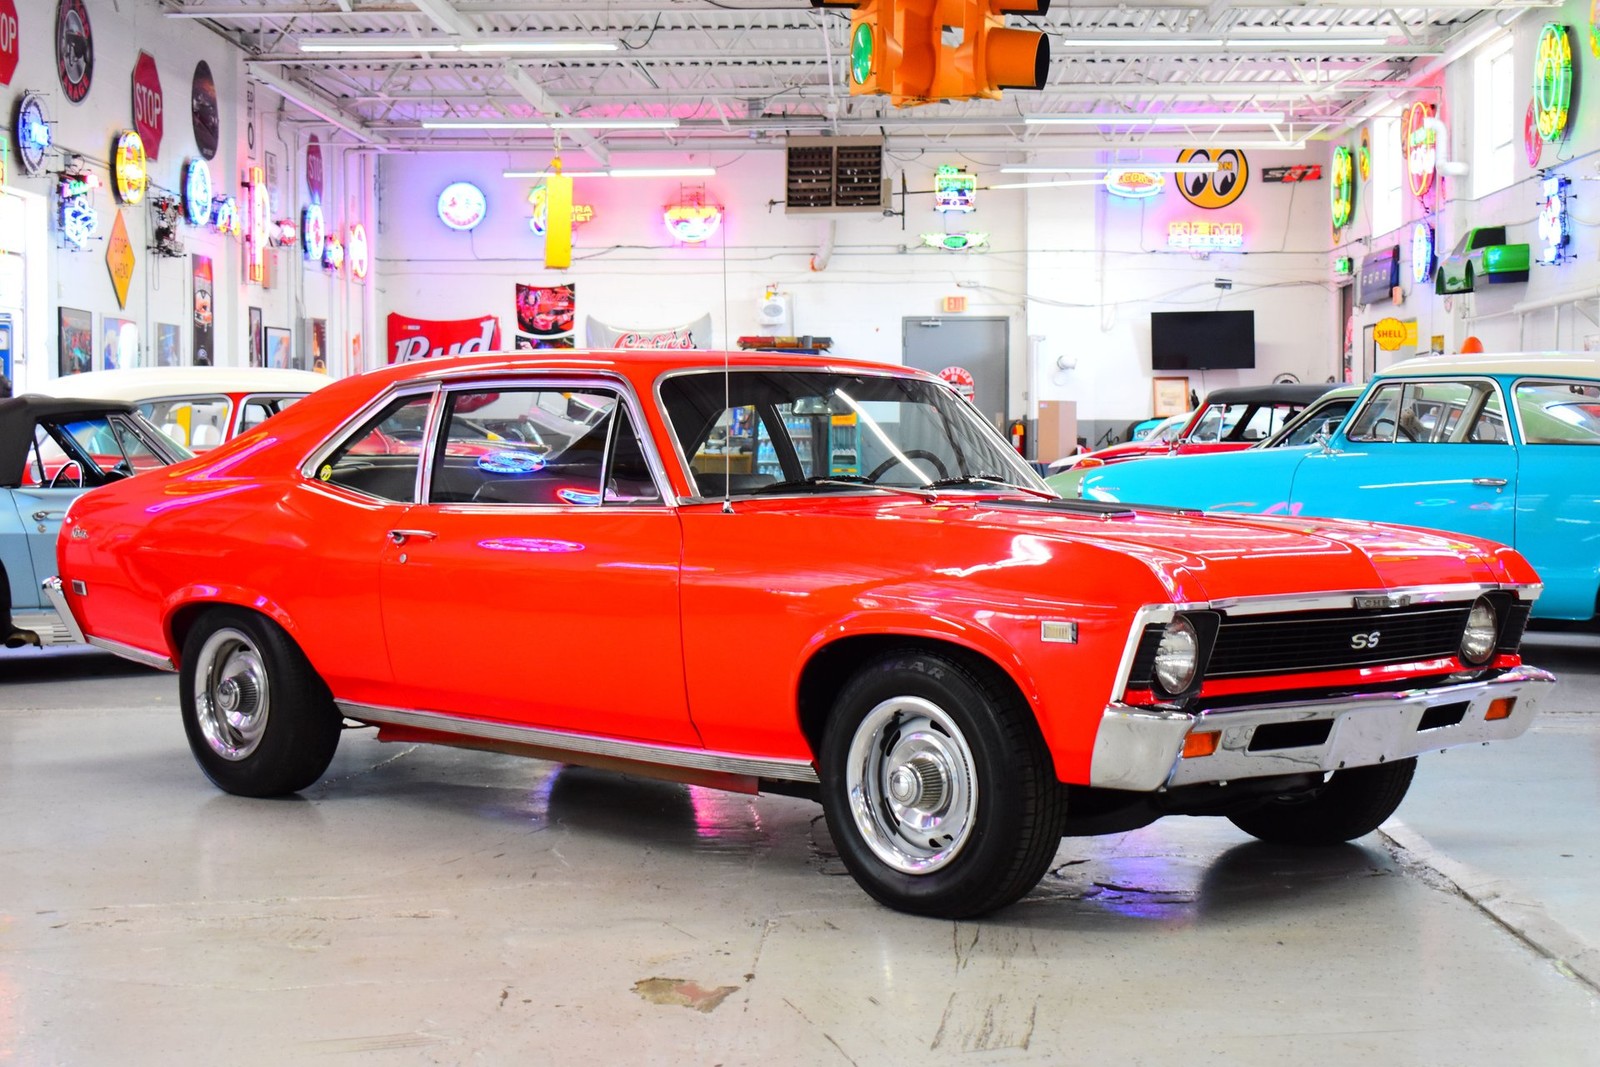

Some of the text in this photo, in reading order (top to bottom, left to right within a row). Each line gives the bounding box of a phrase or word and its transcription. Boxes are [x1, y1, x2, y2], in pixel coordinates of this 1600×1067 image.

[135, 82, 161, 130] STOP
[947, 297, 966, 311] EXIT
[395, 319, 496, 363] Bud
[1377, 329, 1402, 338] SHELL
[1350, 631, 1381, 649] SS
